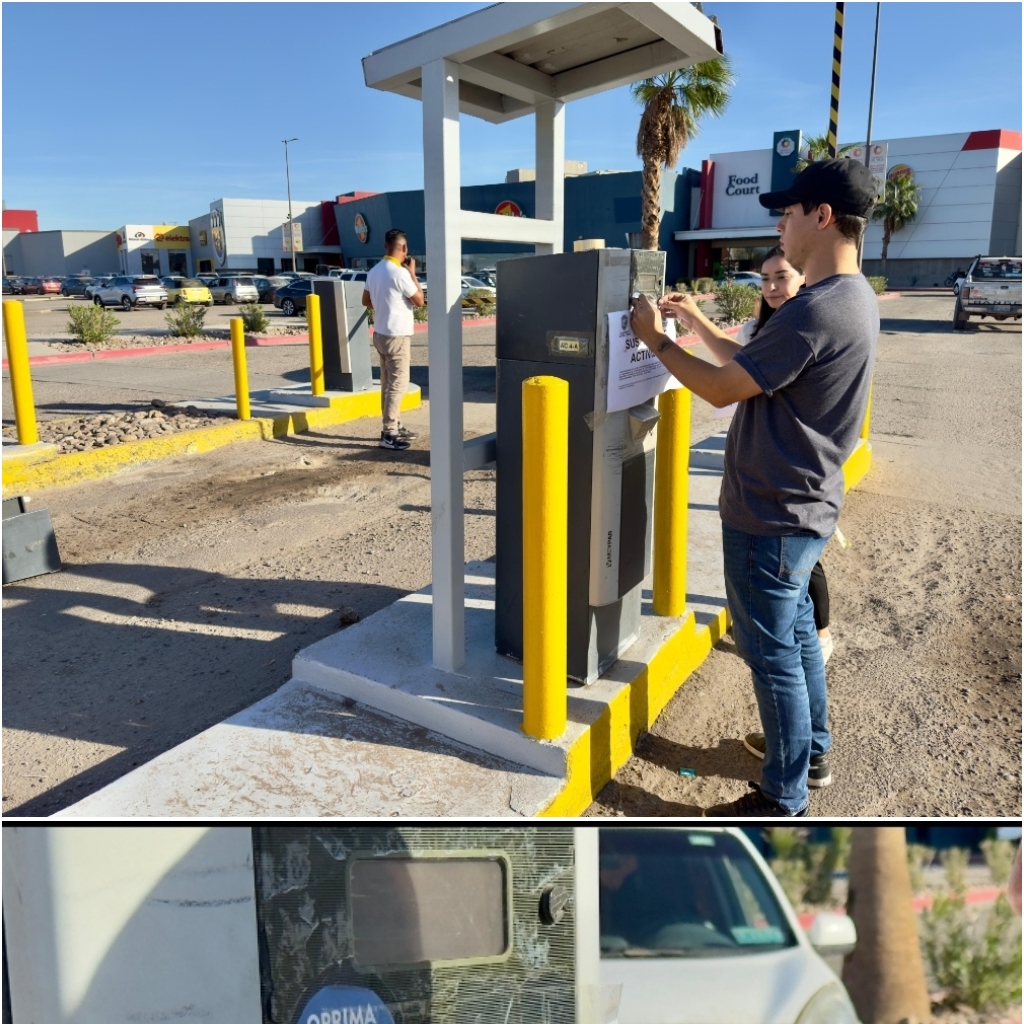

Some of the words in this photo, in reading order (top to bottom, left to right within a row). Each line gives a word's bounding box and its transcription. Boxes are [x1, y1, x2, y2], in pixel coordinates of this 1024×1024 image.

[728, 173, 758, 186] Food
[726, 185, 760, 196] Court
[165, 233, 189, 241] elektra
